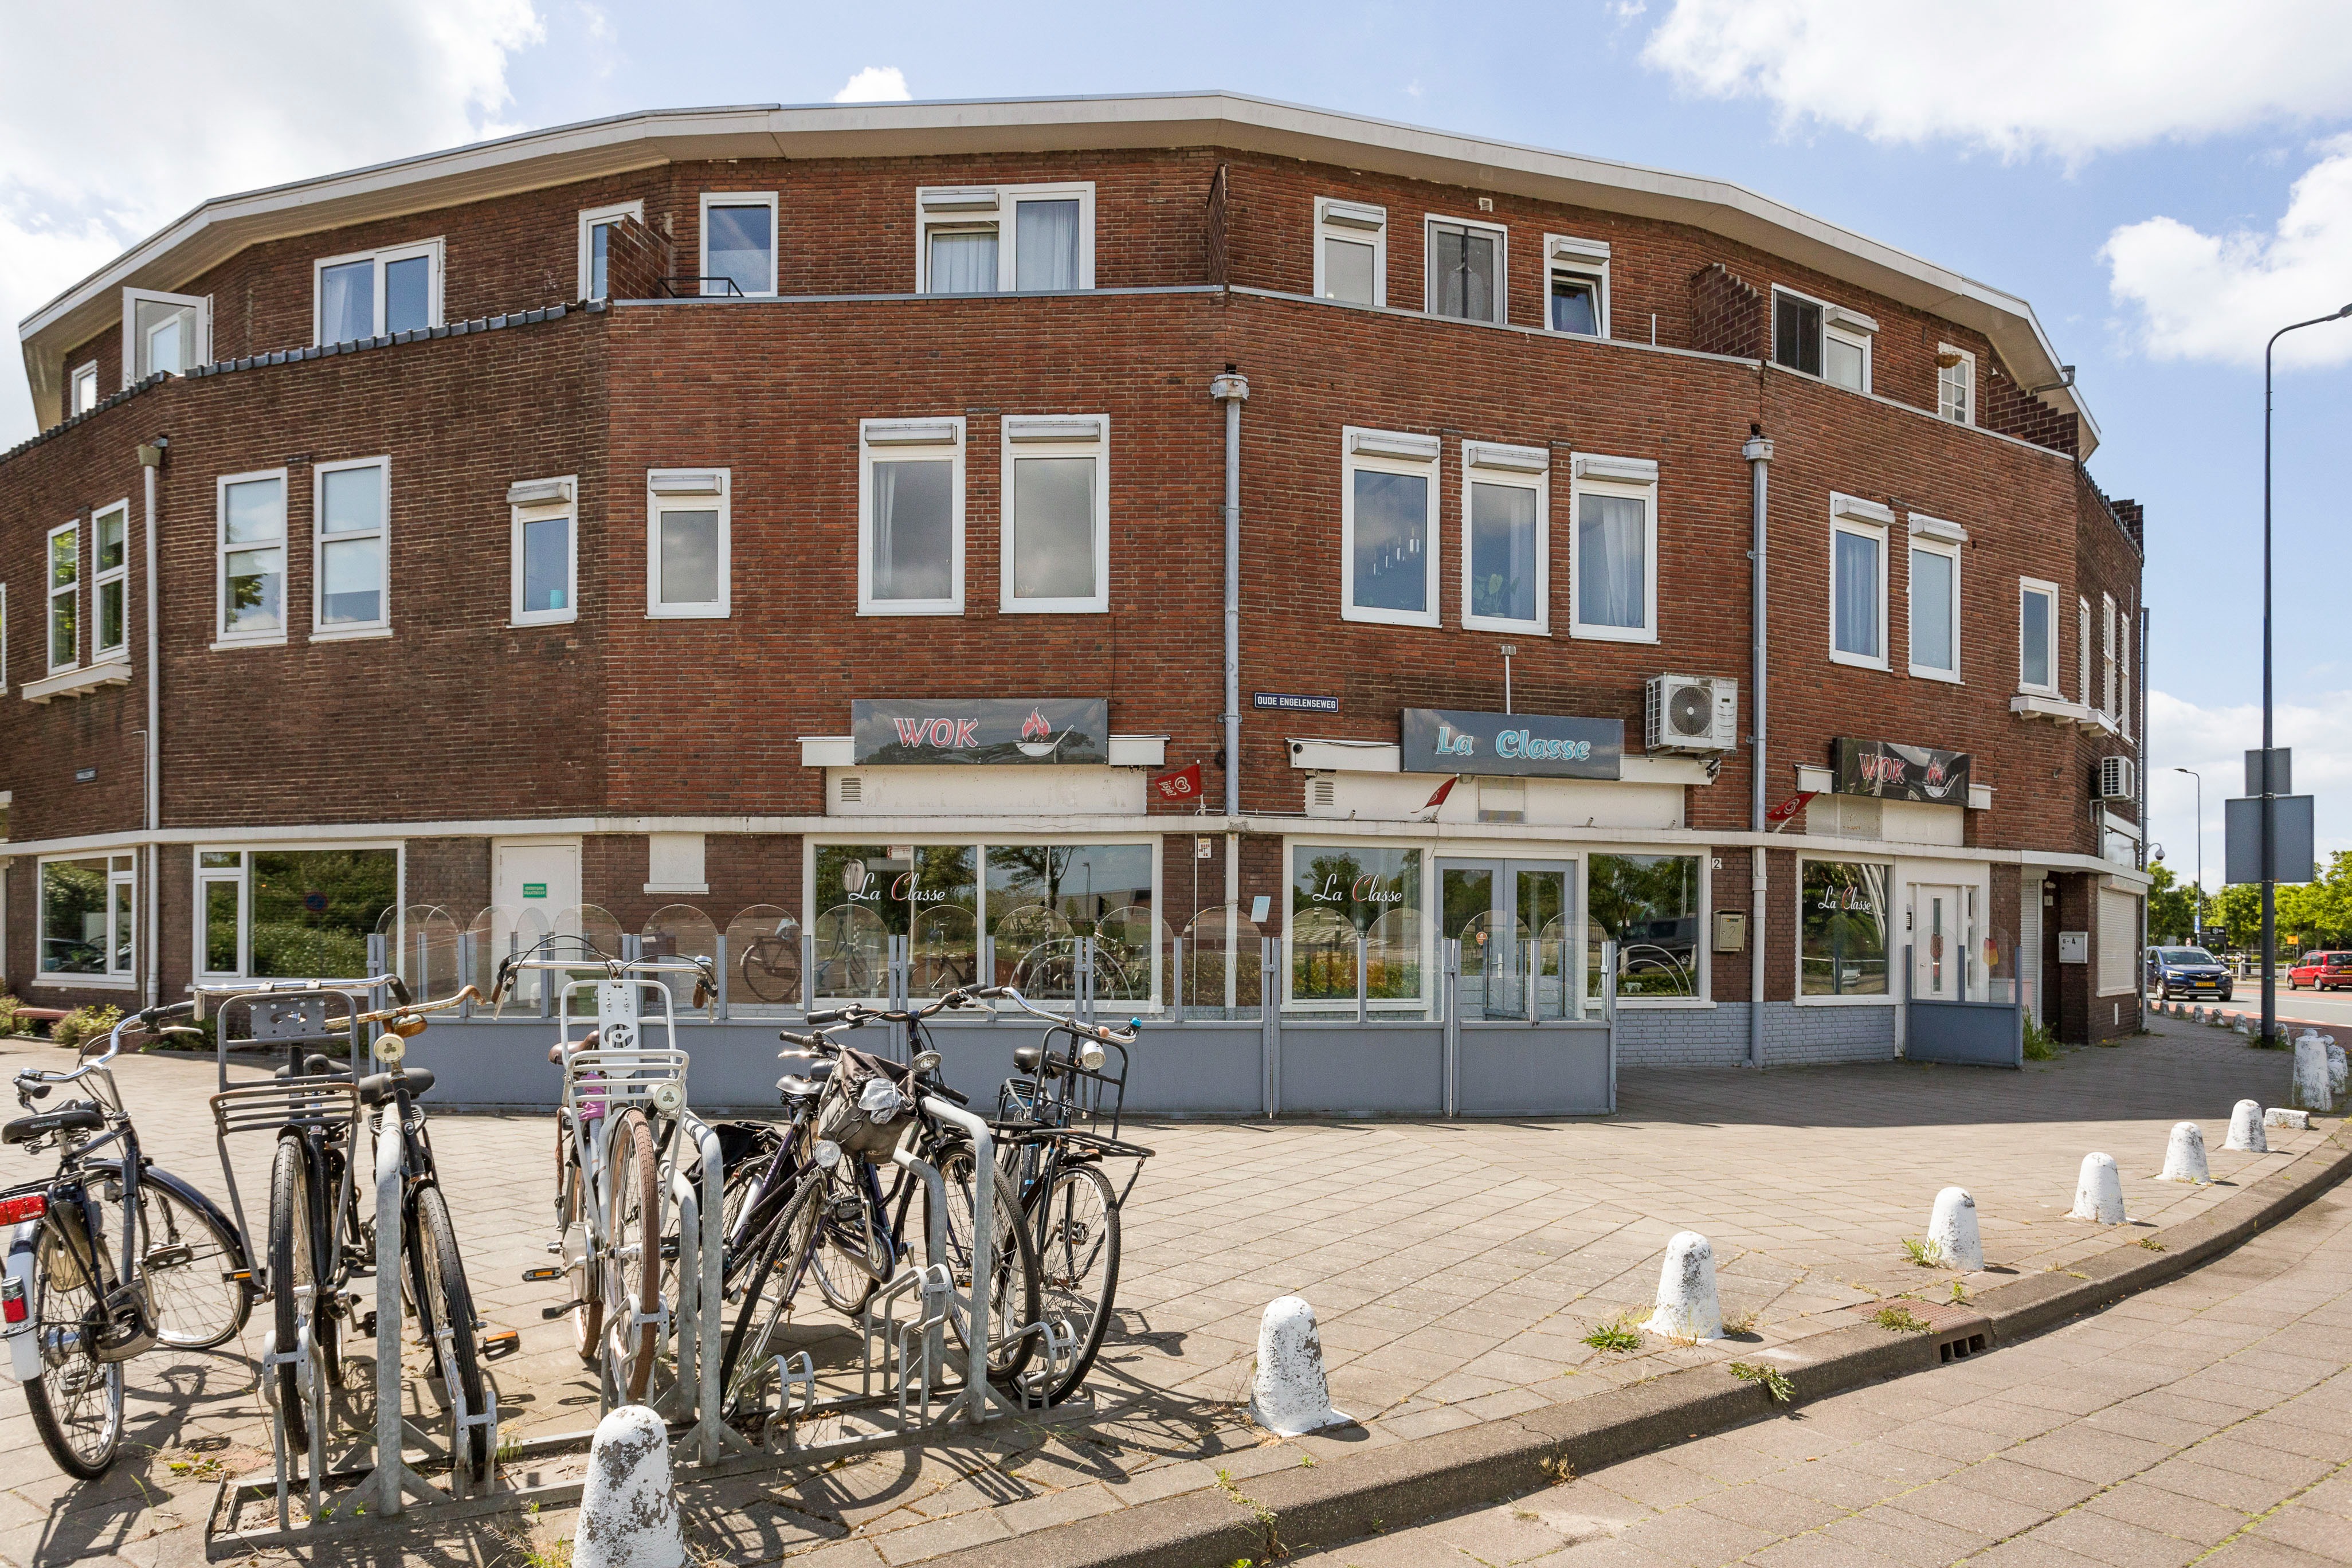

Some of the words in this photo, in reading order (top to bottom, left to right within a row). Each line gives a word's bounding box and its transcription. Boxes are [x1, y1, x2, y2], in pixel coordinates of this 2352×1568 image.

[1257, 696, 1277, 705] OUDE
[1280, 697, 1336, 709] ENGELENSEWEG
[893, 718, 979, 748] WOK
[1435, 726, 1474, 756] La
[1495, 730, 1591, 761] Classe
[1859, 753, 1906, 784] WOK
[1714, 859, 1720, 869] 2
[848, 872, 881, 901] La
[891, 872, 946, 901] Classe
[1312, 873, 1343, 901] La
[1352, 873, 1402, 903] Classe
[1818, 885, 1837, 909] La
[1841, 885, 1871, 911] Classe
